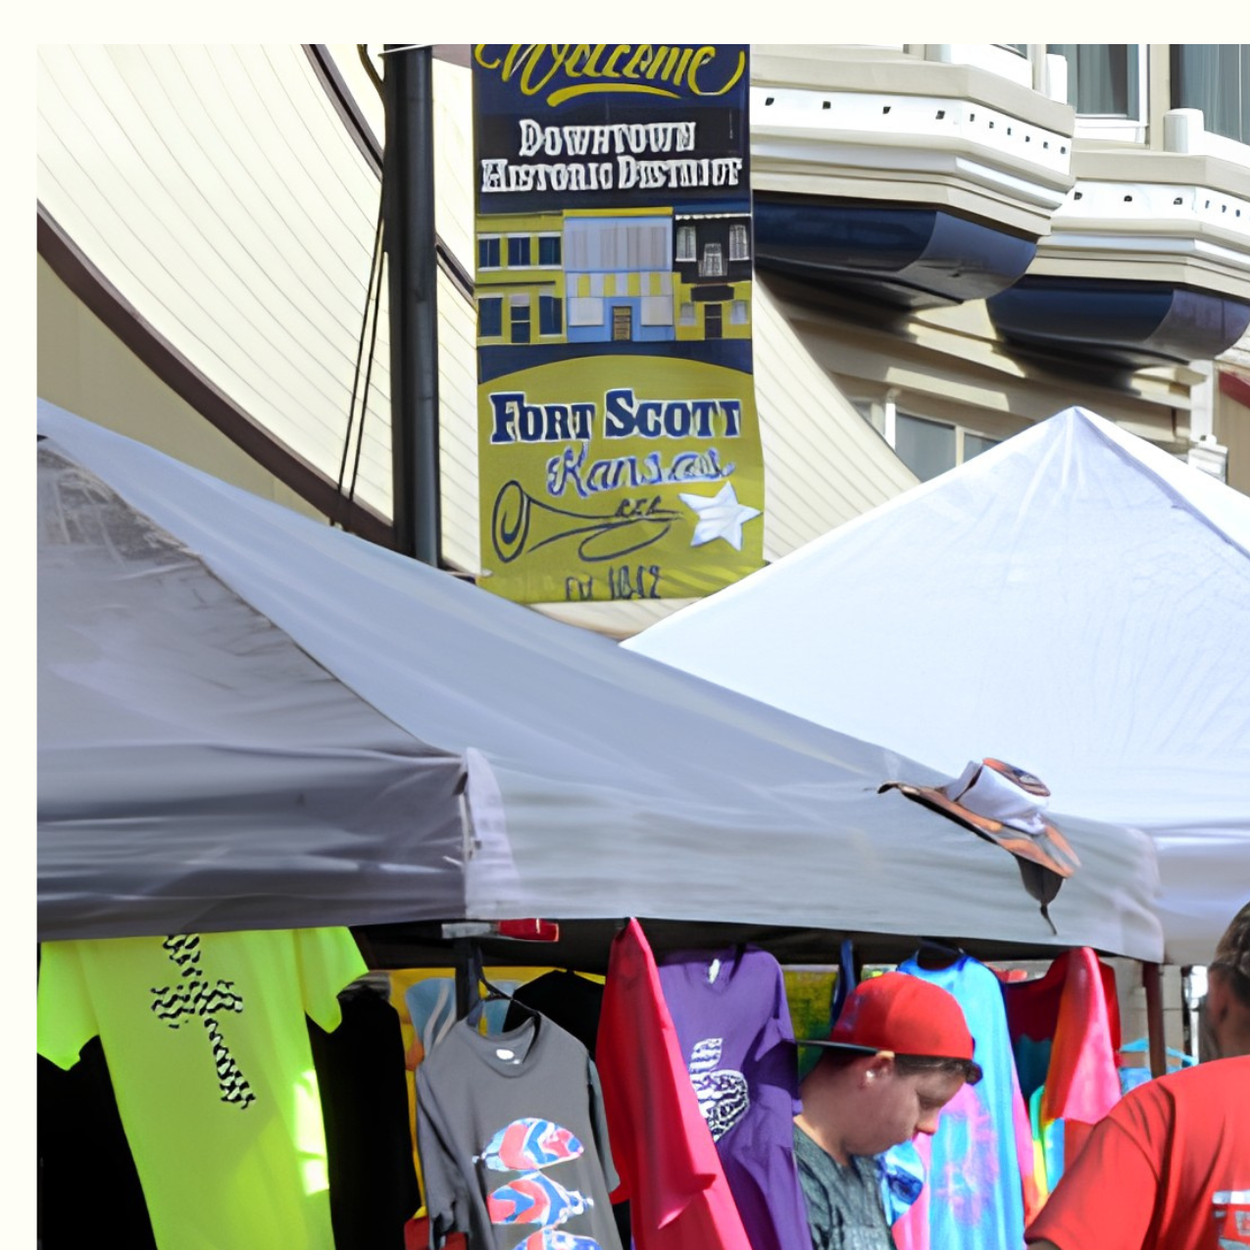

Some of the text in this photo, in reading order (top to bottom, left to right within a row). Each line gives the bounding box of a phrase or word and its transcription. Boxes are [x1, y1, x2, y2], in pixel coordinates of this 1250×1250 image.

[489, 387, 742, 444] FORT SCOTT
[546, 441, 736, 499] Kansas
